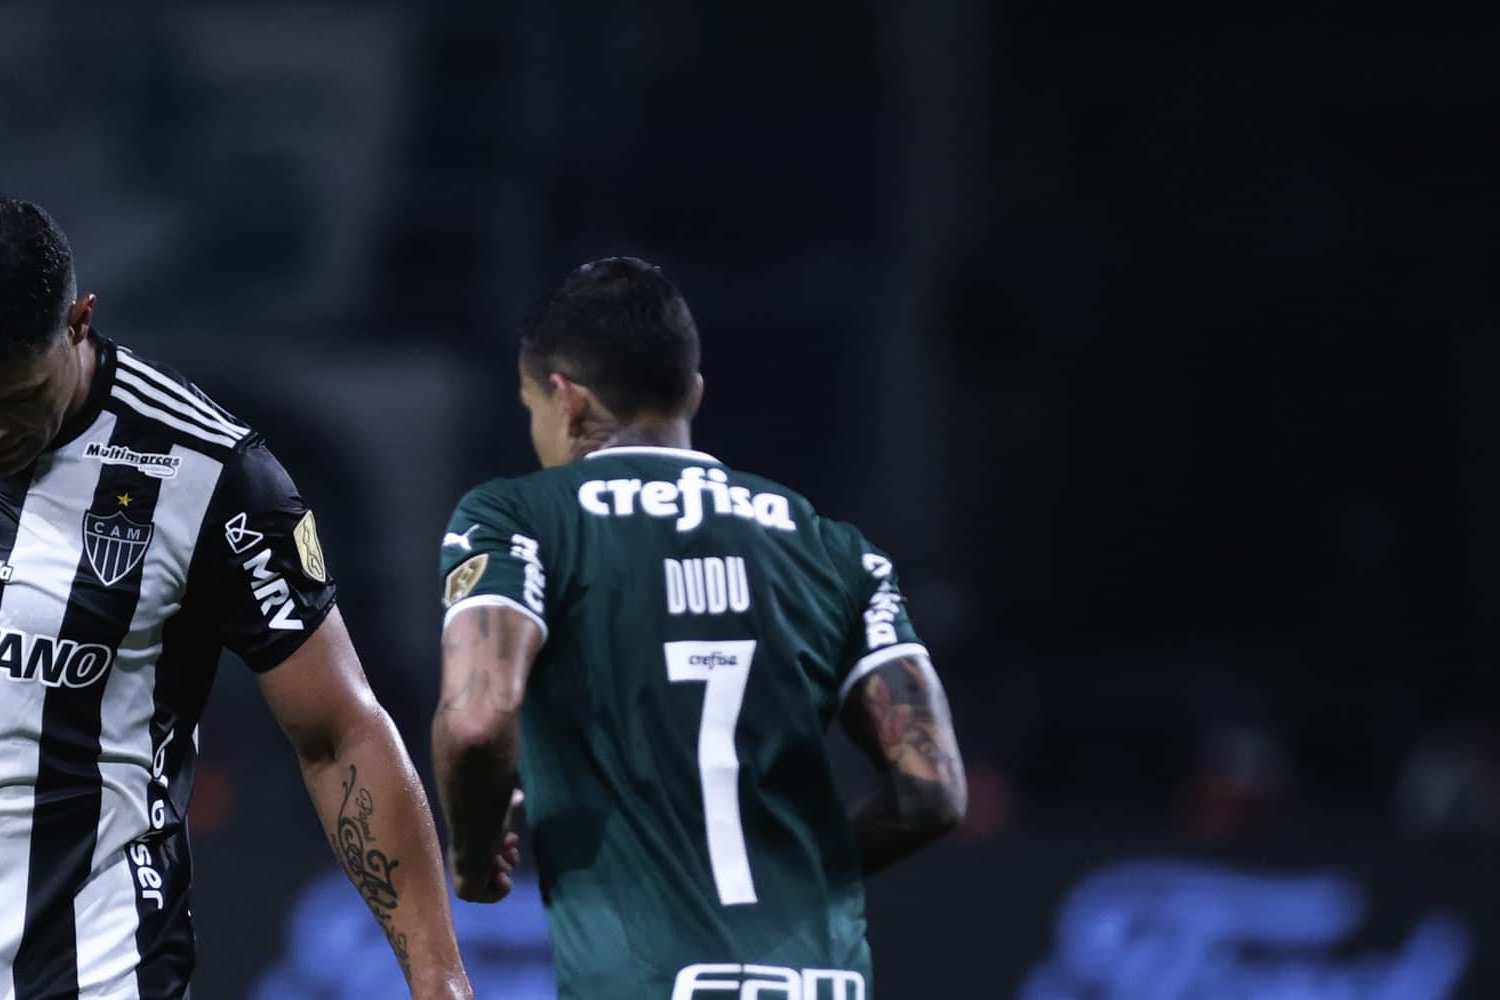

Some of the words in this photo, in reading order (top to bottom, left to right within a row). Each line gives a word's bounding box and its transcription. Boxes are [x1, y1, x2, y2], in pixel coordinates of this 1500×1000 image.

[85, 443, 181, 467] Multimarcas
[578, 466, 797, 532] crefisa
[242, 547, 305, 630] MRV
[663, 556, 750, 614] DUDU
[688, 652, 738, 670] crefisa
[663, 639, 757, 905] 7
